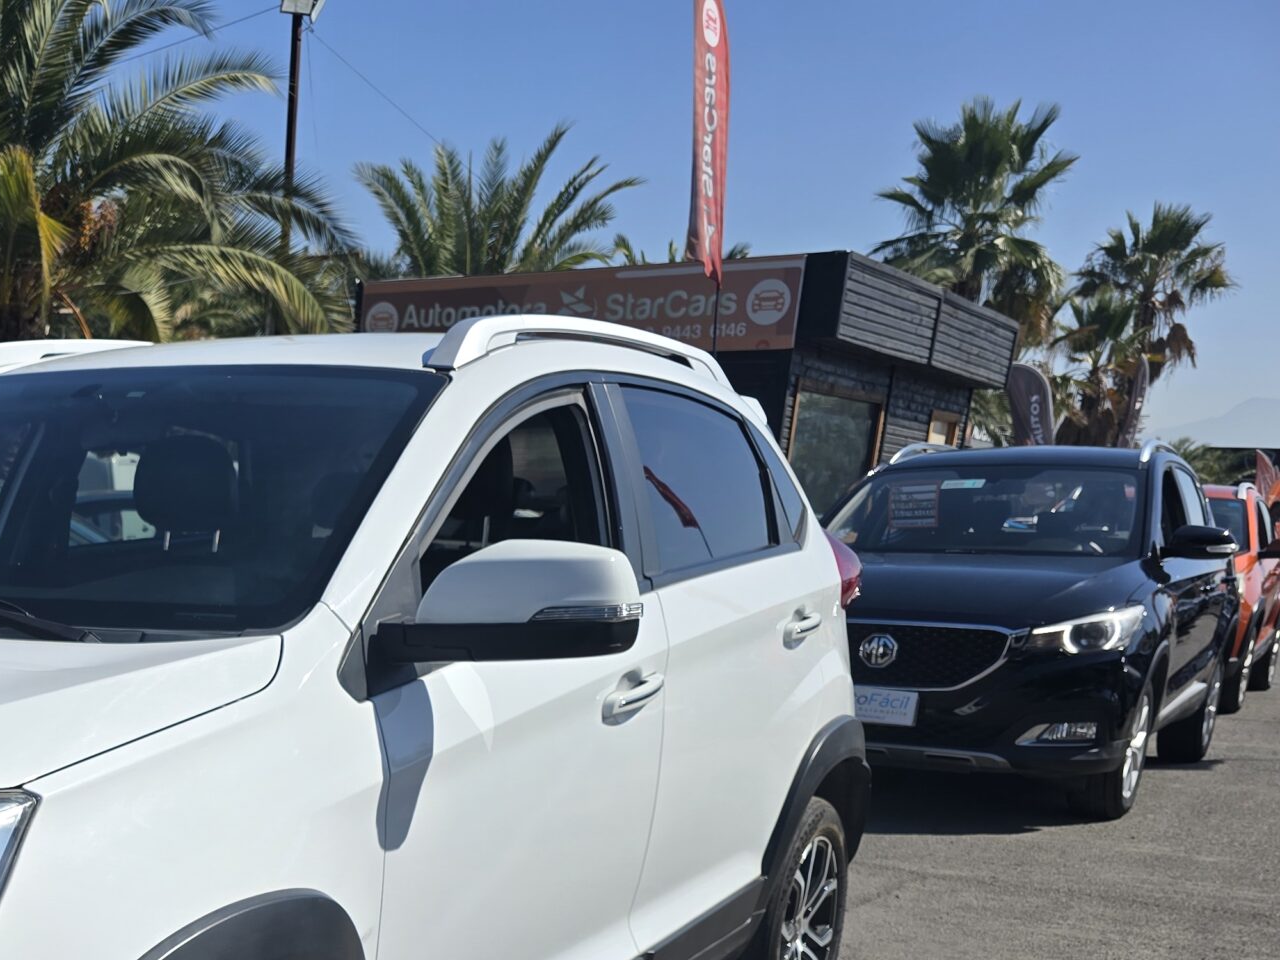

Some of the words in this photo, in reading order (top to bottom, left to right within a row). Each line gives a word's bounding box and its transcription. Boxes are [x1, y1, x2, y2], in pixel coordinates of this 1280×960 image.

[604, 289, 738, 321] StarCars
[710, 322, 748, 338] 6146
[856, 692, 911, 710] oFácil
